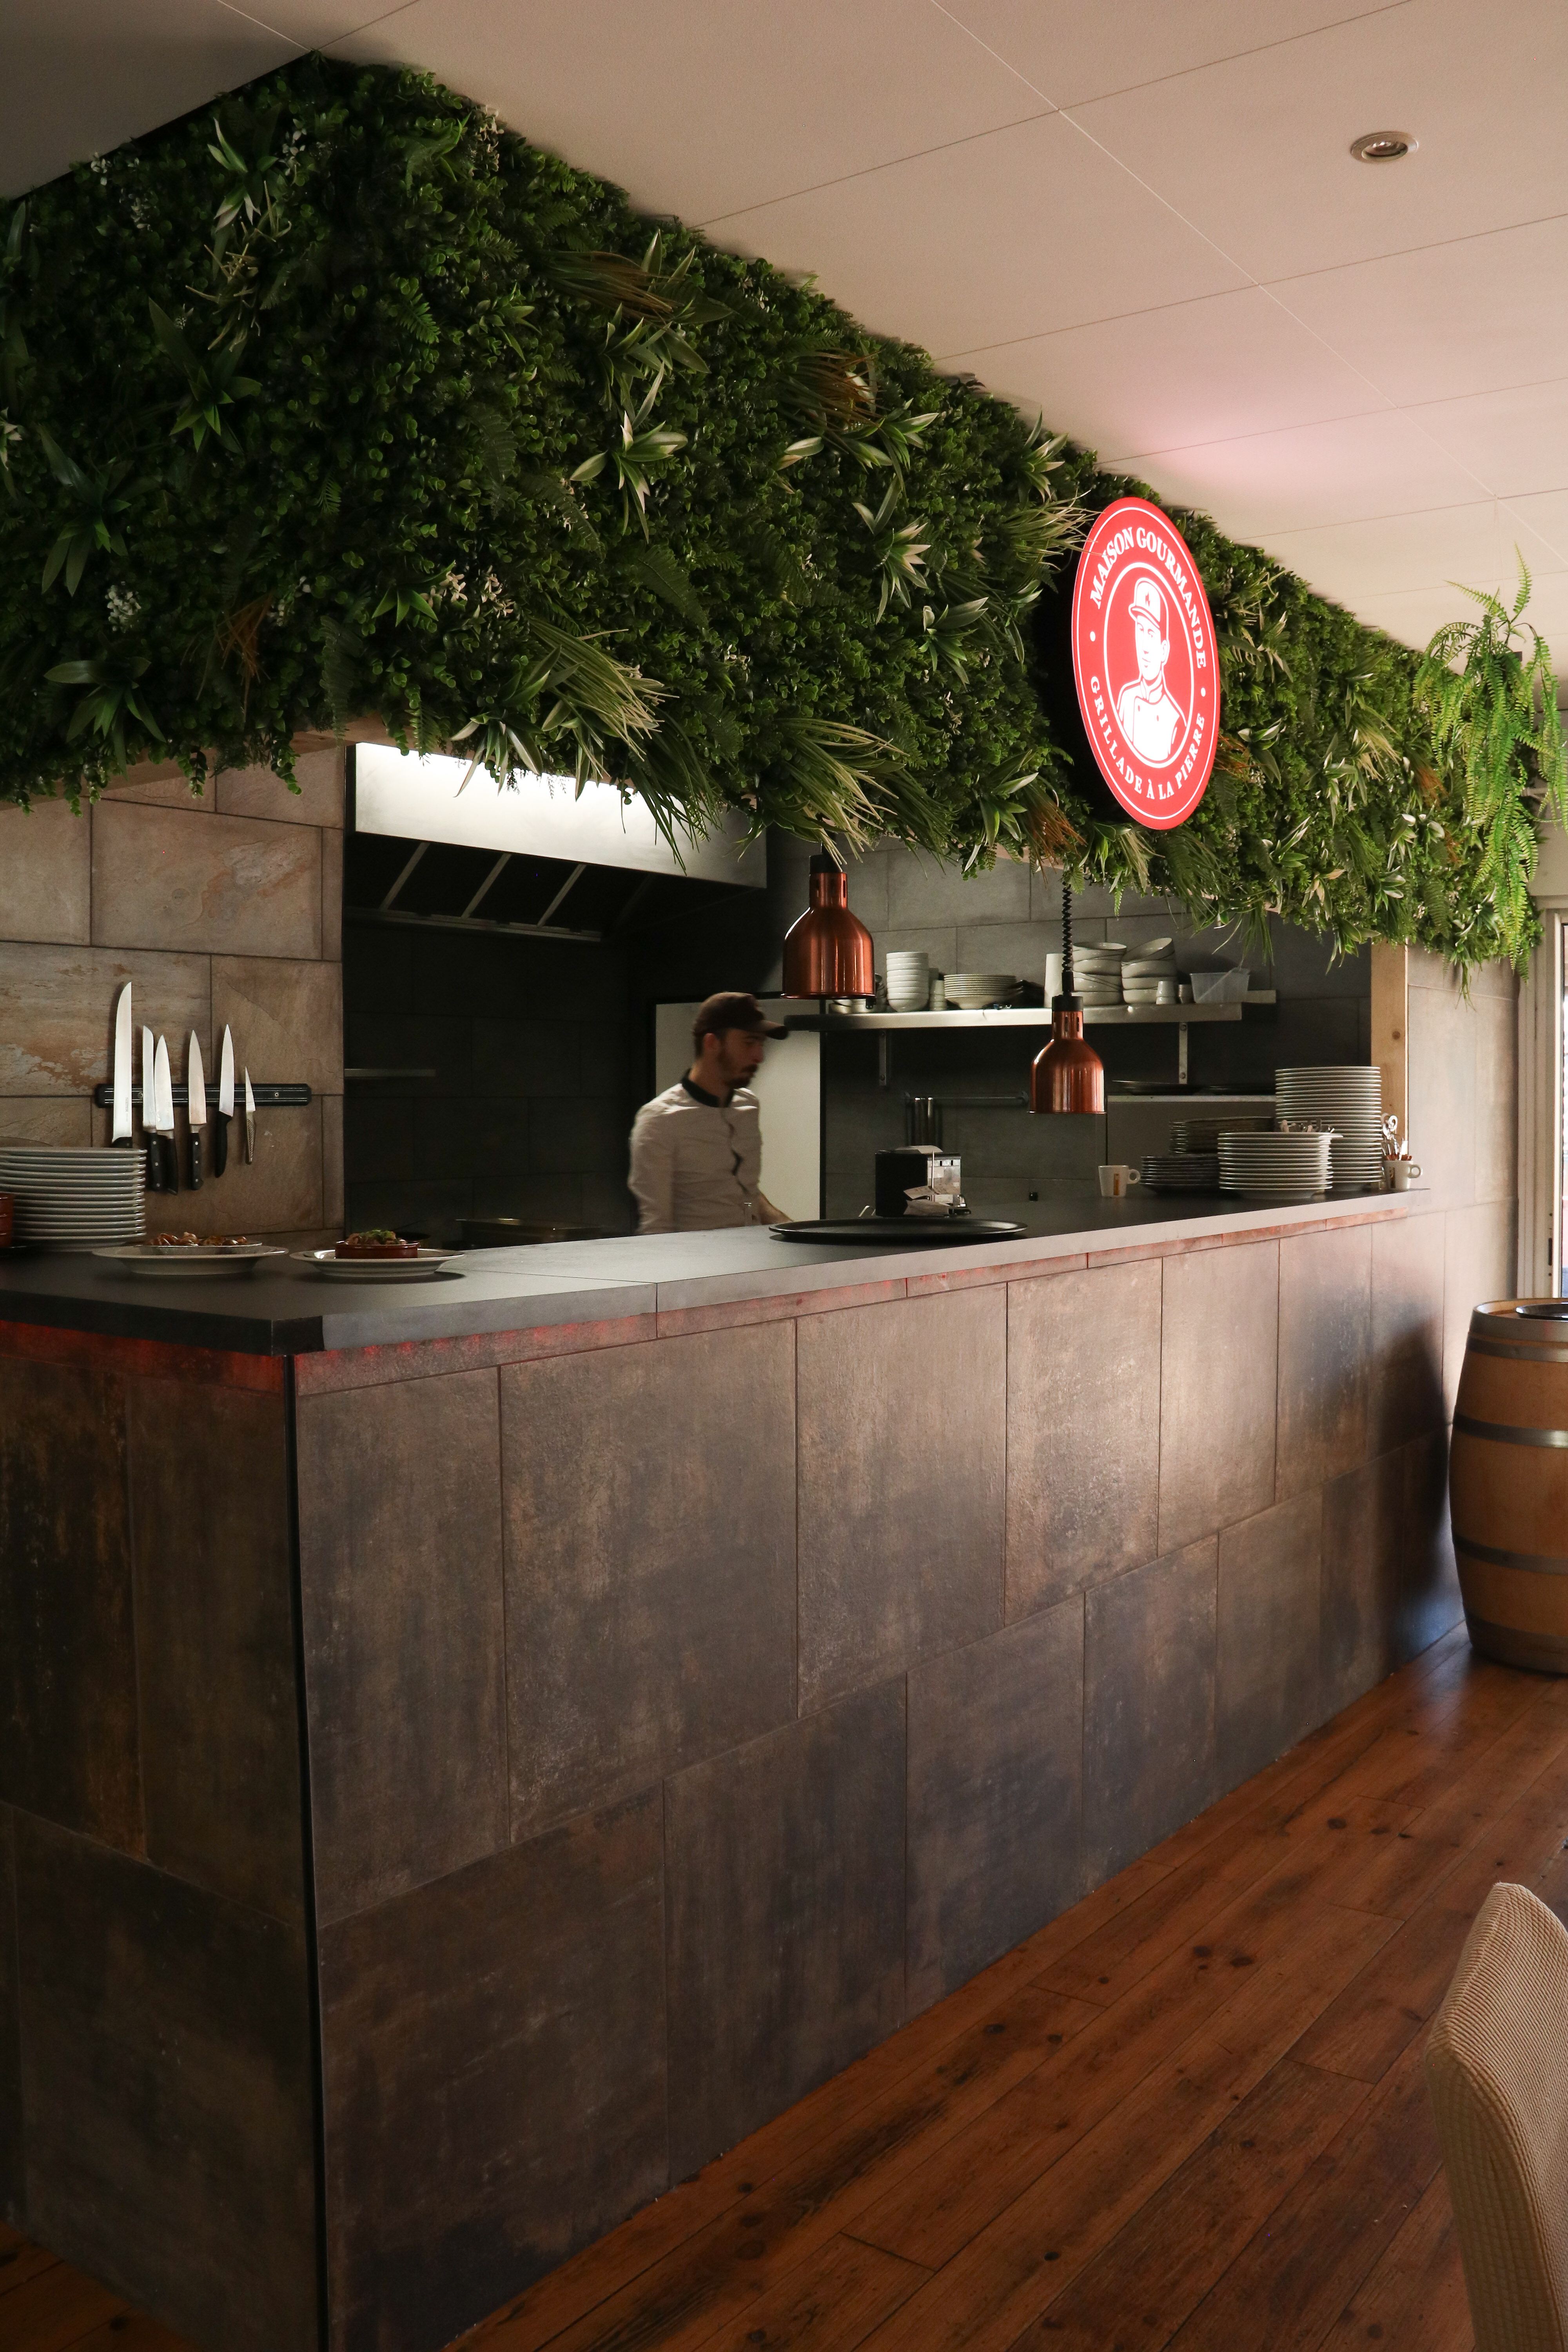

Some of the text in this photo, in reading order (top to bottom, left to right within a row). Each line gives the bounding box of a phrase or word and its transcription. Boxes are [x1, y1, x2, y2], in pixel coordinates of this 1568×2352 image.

[1090, 526, 1206, 668] MAISON GOURMANDE
[1091, 676, 1205, 800] GRILLADE À LA PIERRE
